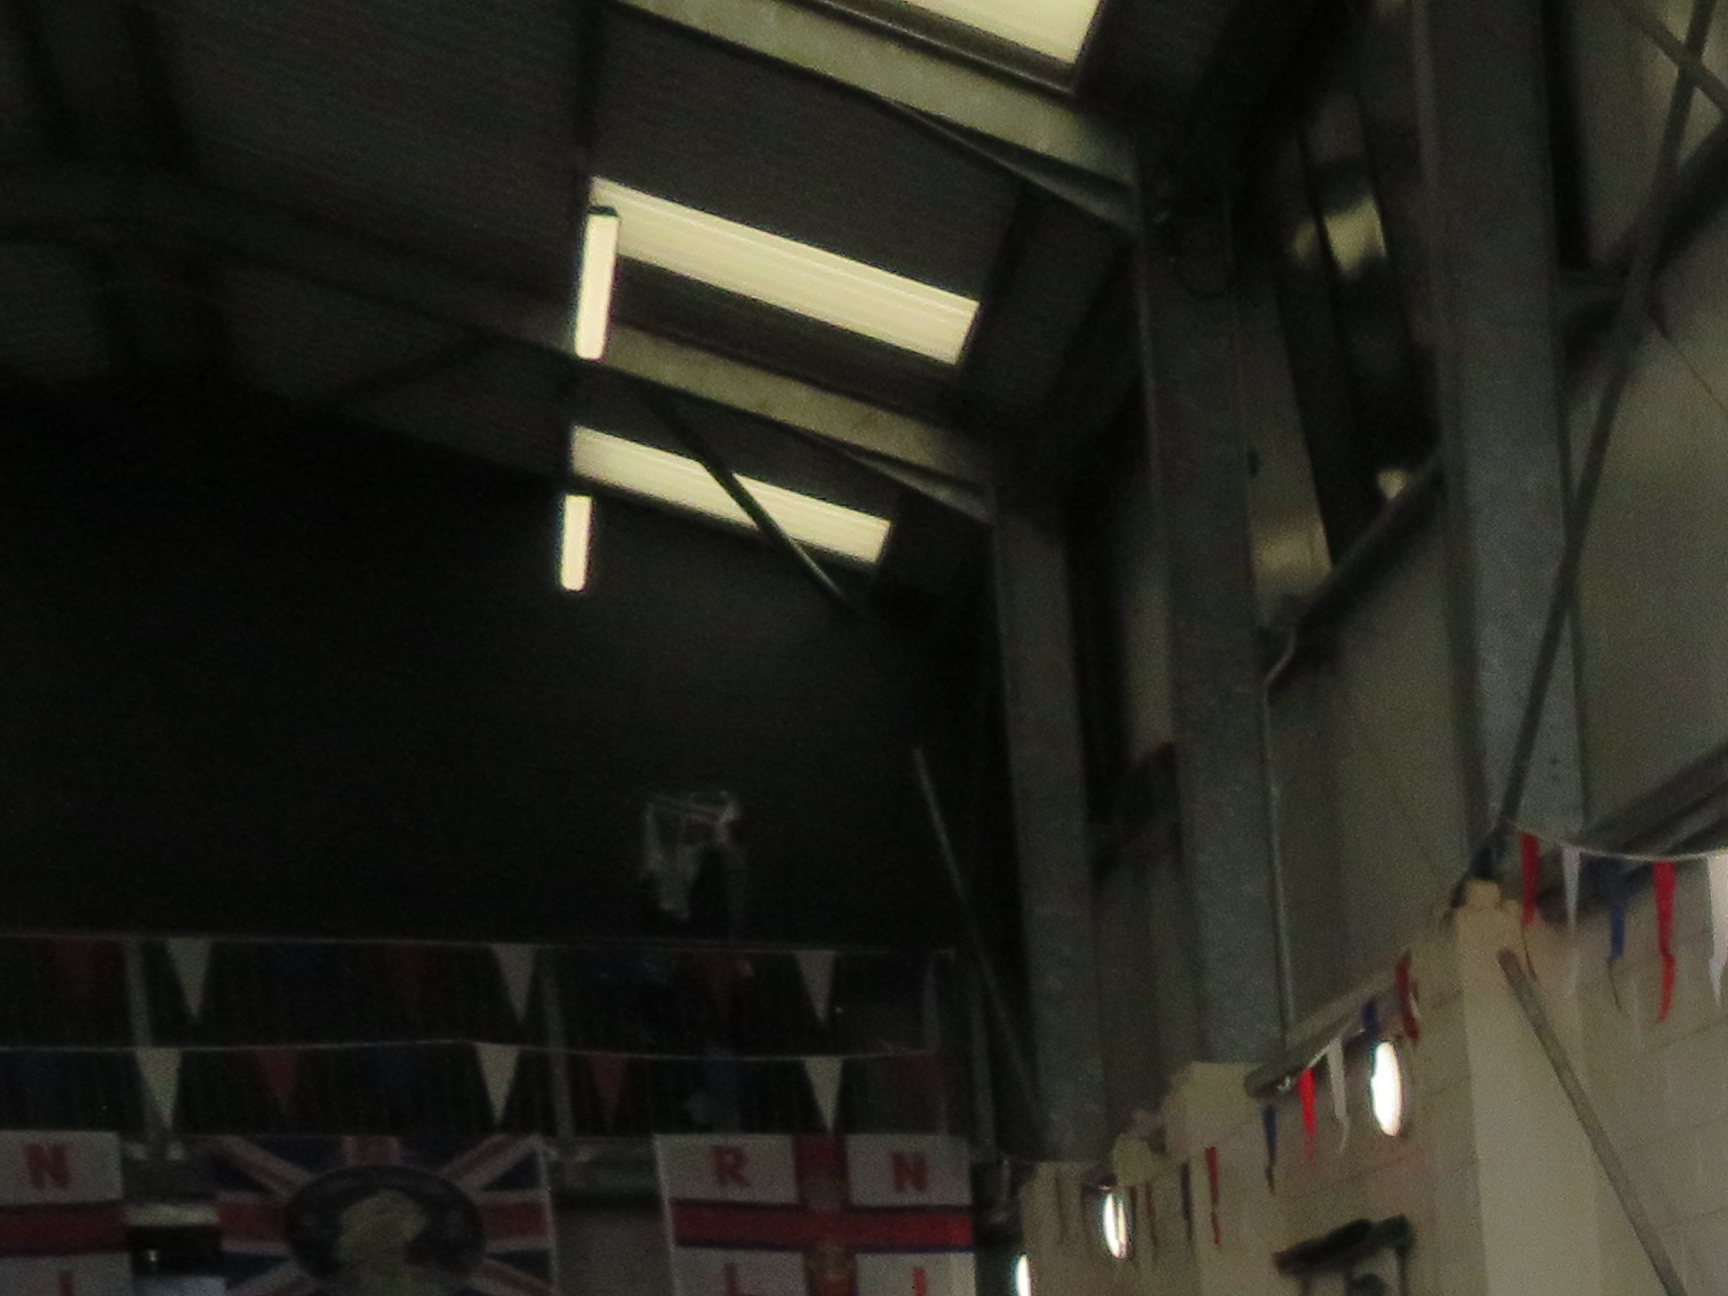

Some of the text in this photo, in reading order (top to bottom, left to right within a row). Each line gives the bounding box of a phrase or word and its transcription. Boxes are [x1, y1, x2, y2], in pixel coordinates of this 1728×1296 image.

[22, 1143, 71, 1189] N
[712, 1145, 928, 1192] R N
